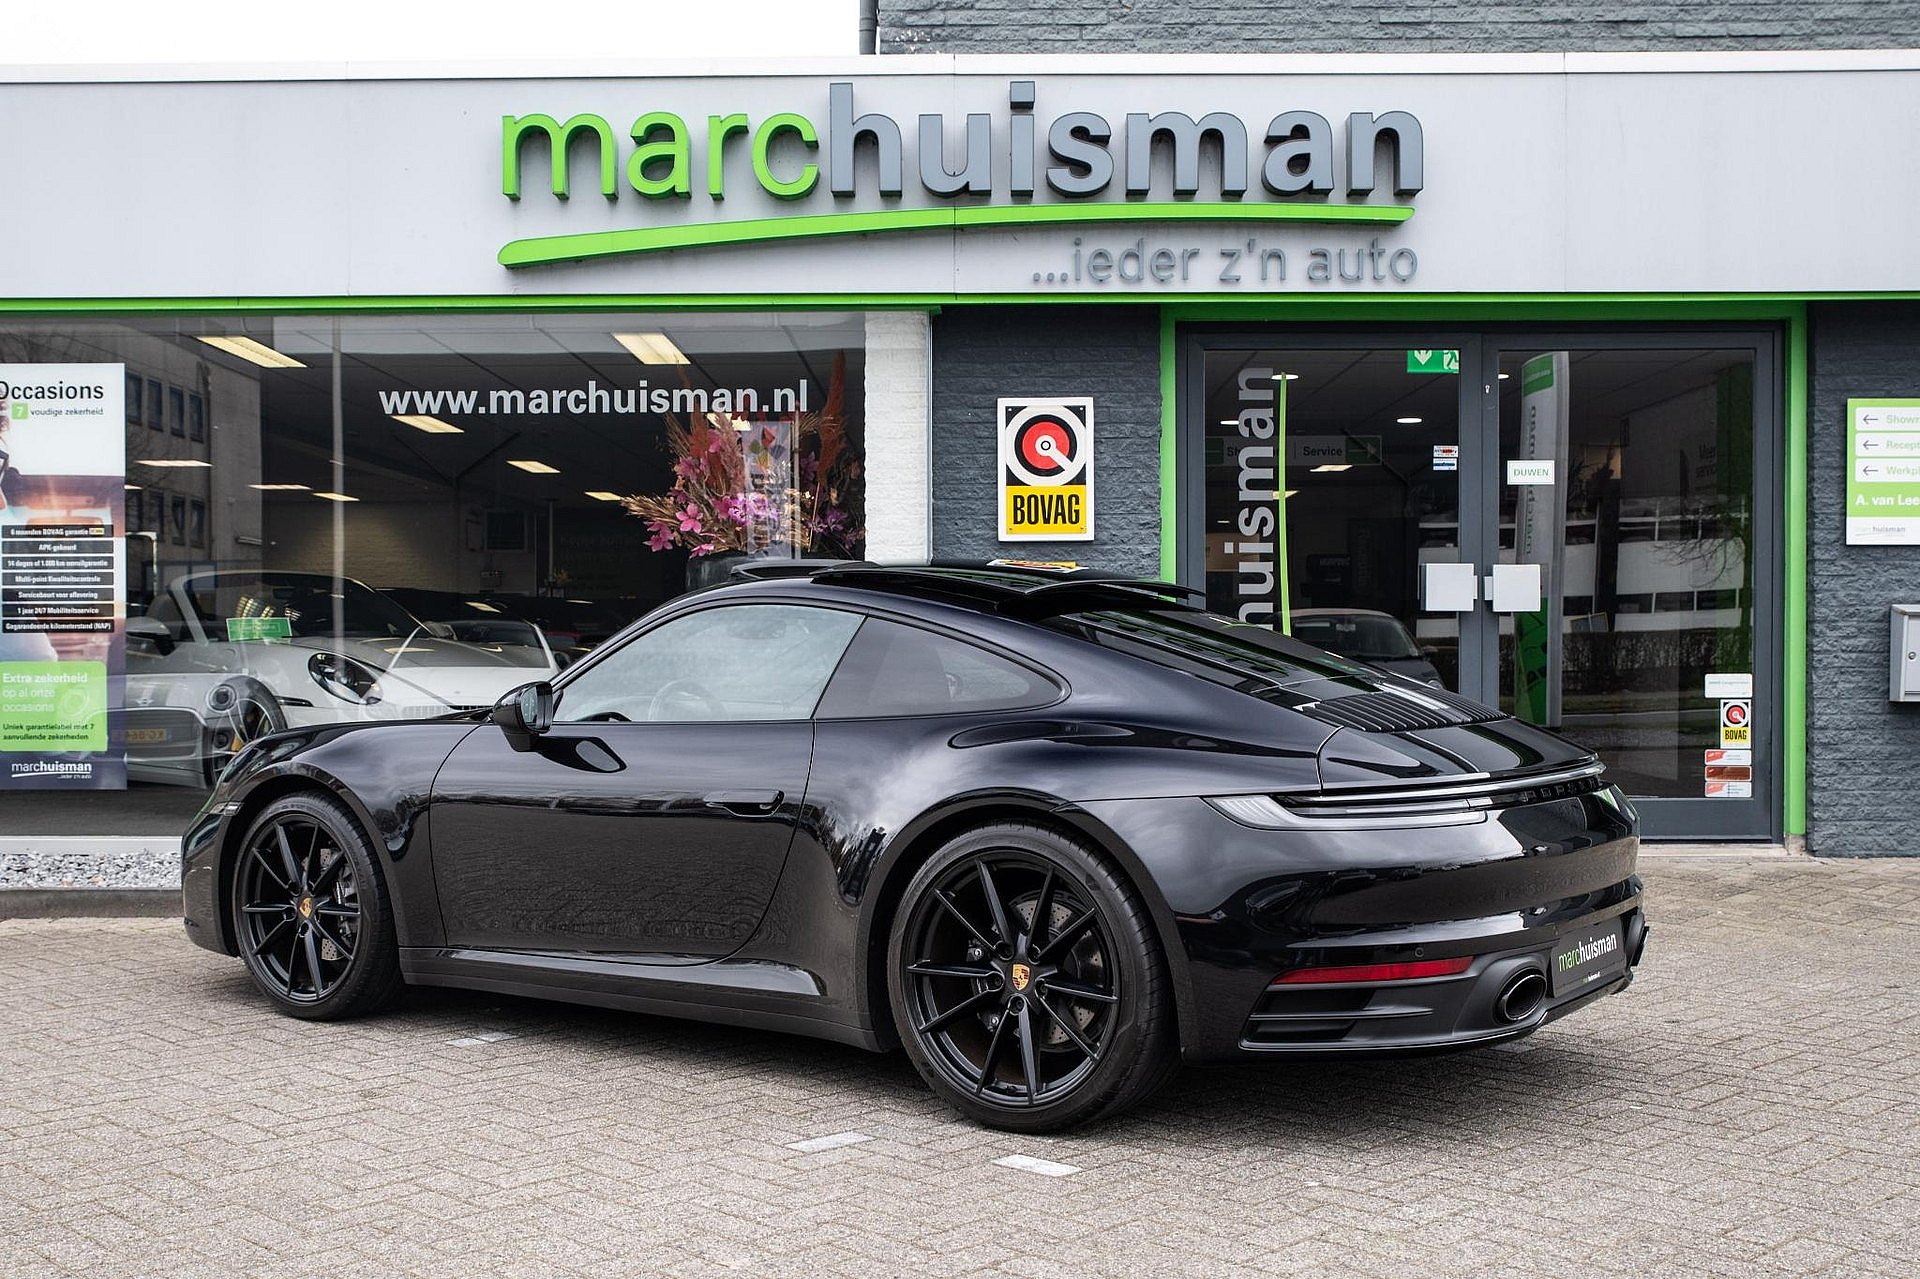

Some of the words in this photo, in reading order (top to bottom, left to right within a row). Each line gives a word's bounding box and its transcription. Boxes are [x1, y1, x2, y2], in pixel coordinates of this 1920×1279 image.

[502, 82, 1424, 201] marchuisman
[1033, 238, 1200, 283] ...ieder
[1219, 238, 1286, 283] z'n
[1307, 238, 1418, 283] auto
[379, 379, 808, 415] www.marchuisman.nl
[16, 406, 23, 417] 7
[30, 407, 62, 417] voudige
[65, 407, 104, 416] zekerheid
[1303, 445, 1343, 457] Service
[1513, 468, 1549, 477] DUWEN
[1855, 494, 1869, 506] A.
[1872, 496, 1894, 506] van
[1013, 494, 1080, 525] BOVAG
[2, 673, 33, 684] Extra
[35, 673, 88, 684] zekerheid
[2, 689, 16, 699] op
[19, 687, 28, 698] al
[30, 688, 55, 698] onze
[2, 703, 55, 712] occasions
[1724, 730, 1747, 740] BOVAG
[11, 761, 93, 772] marchuisman
[1558, 932, 1617, 972] marchuisman
